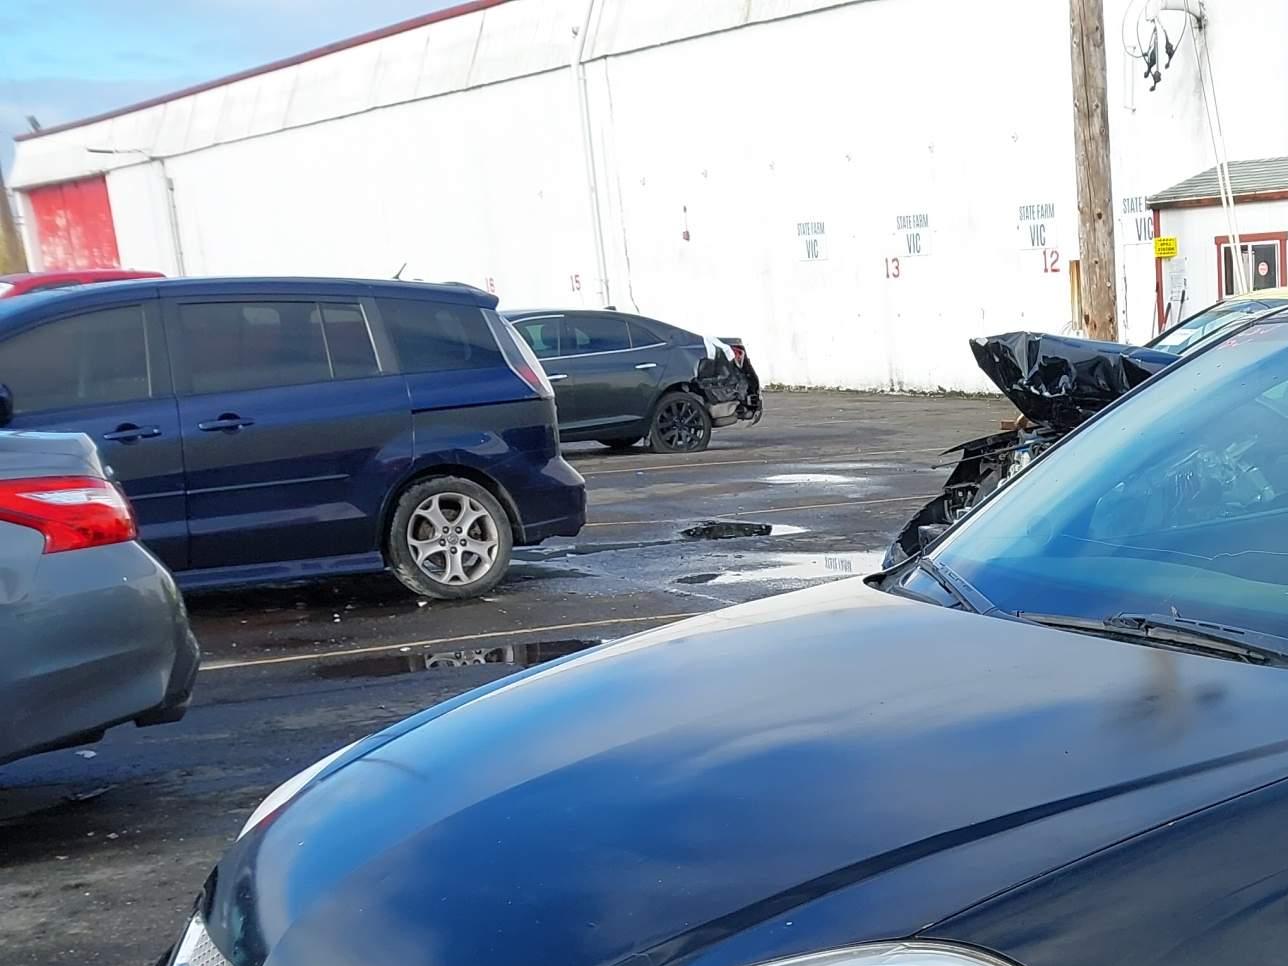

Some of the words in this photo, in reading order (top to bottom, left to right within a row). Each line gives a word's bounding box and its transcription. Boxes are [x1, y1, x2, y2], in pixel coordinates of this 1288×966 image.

[1019, 206, 1036, 221] STATE
[1037, 203, 1055, 218] FARM
[1122, 196, 1143, 214] STATE
[896, 215, 912, 230] STATE
[912, 213, 929, 229] FARM
[1135, 216, 1154, 241] VIC
[906, 233, 921, 255] VIC
[1029, 223, 1046, 247] VIC
[805, 239, 819, 259] VIC
[885, 257, 900, 279] 13
[1042, 250, 1061, 273] 12
[570, 274, 582, 292] 15
